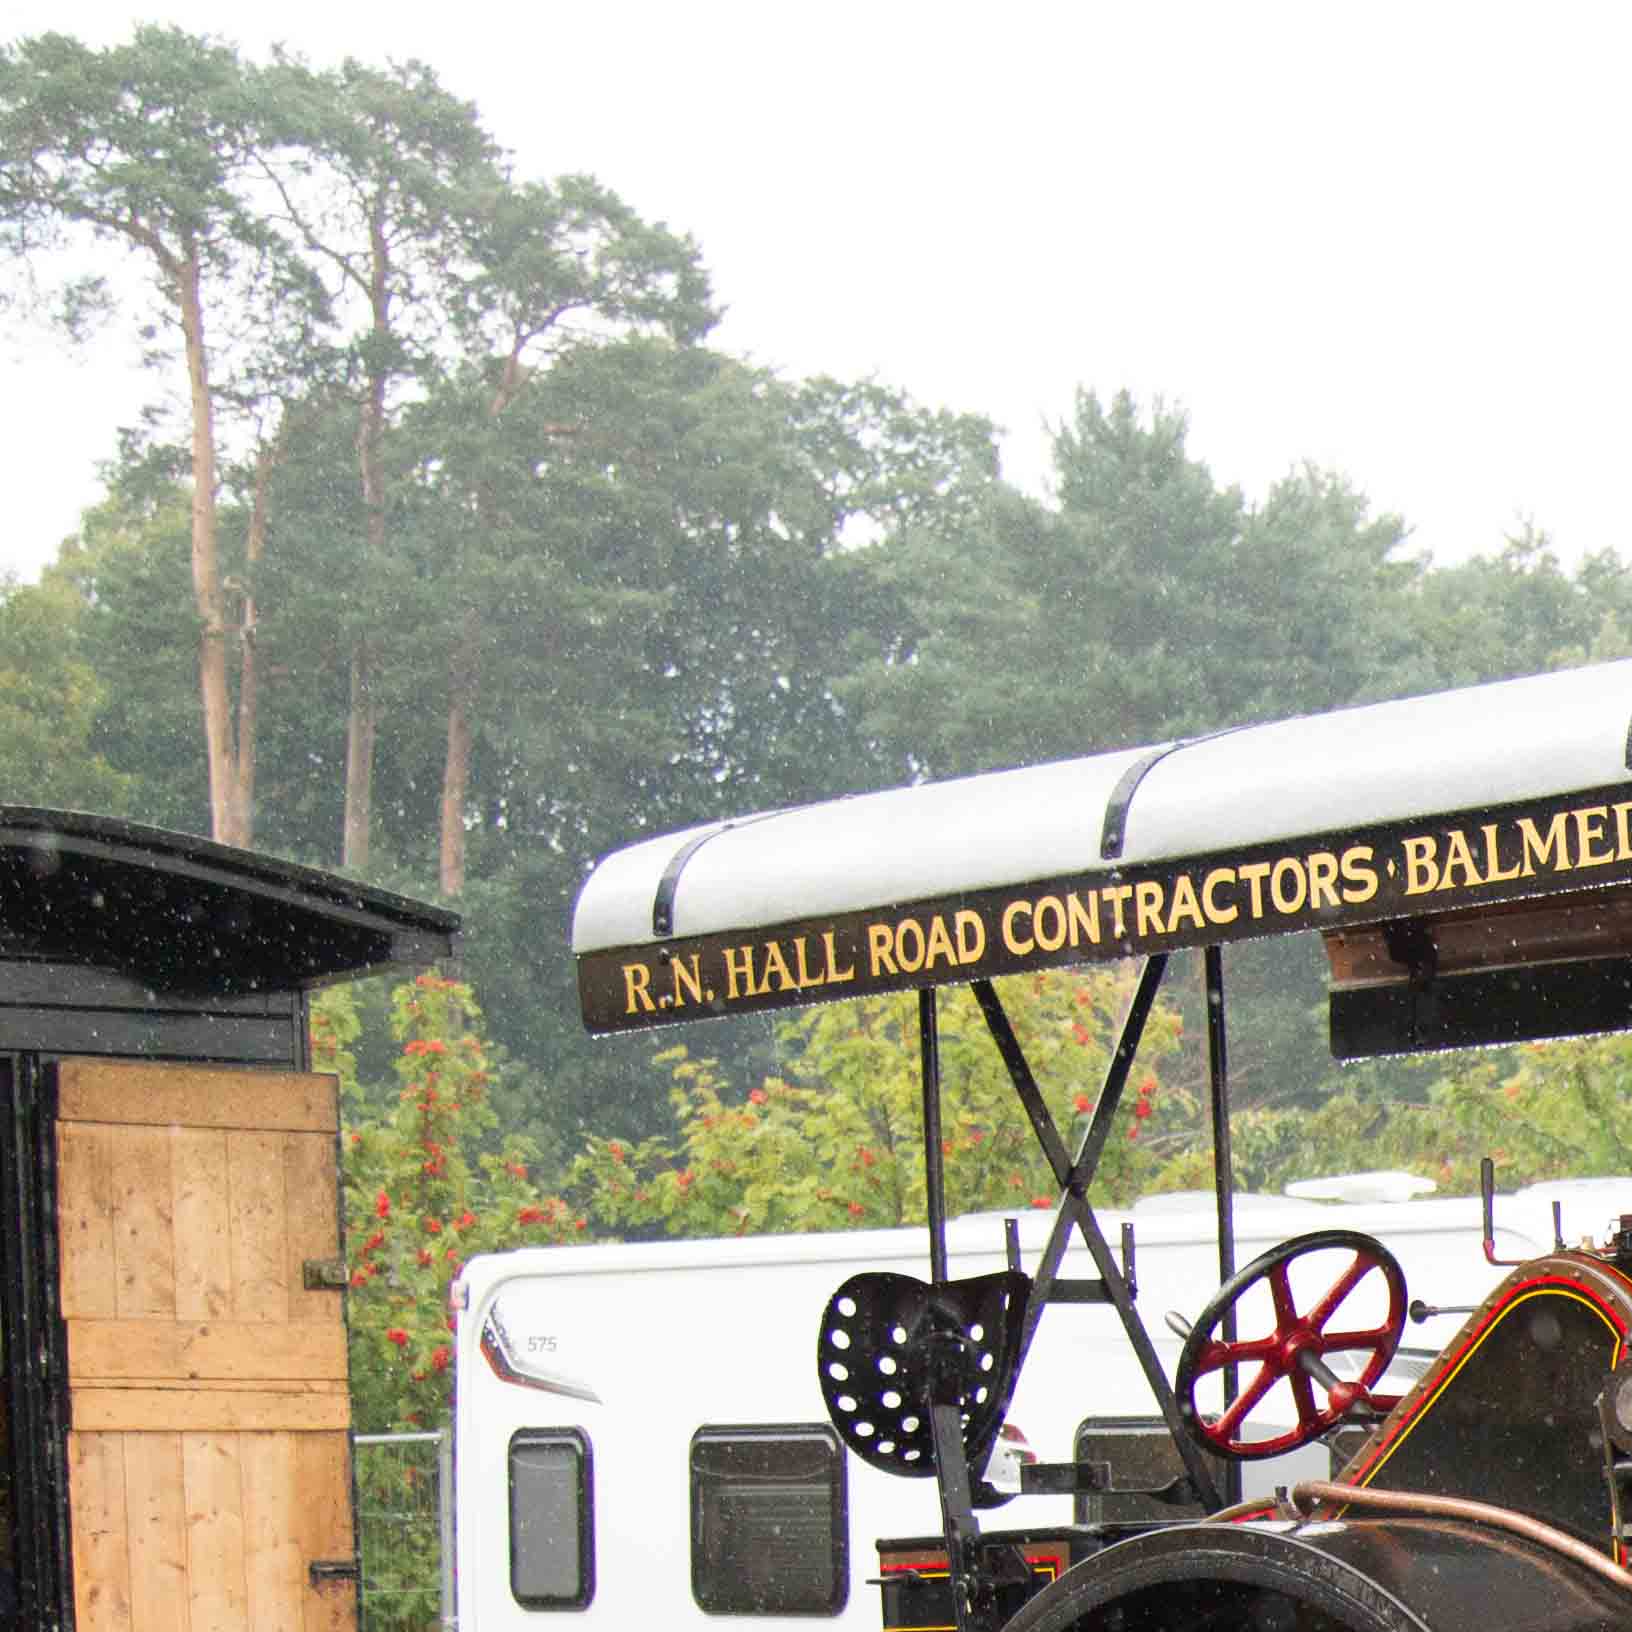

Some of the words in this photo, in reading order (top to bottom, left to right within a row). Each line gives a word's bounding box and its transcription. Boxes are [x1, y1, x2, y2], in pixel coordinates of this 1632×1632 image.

[622, 952, 714, 1015] R.N.
[724, 931, 855, 996] HALL
[868, 909, 987, 977] ROAD
[1002, 845, 1381, 956] CONTRACTORS
[527, 1335, 557, 1352] 575
